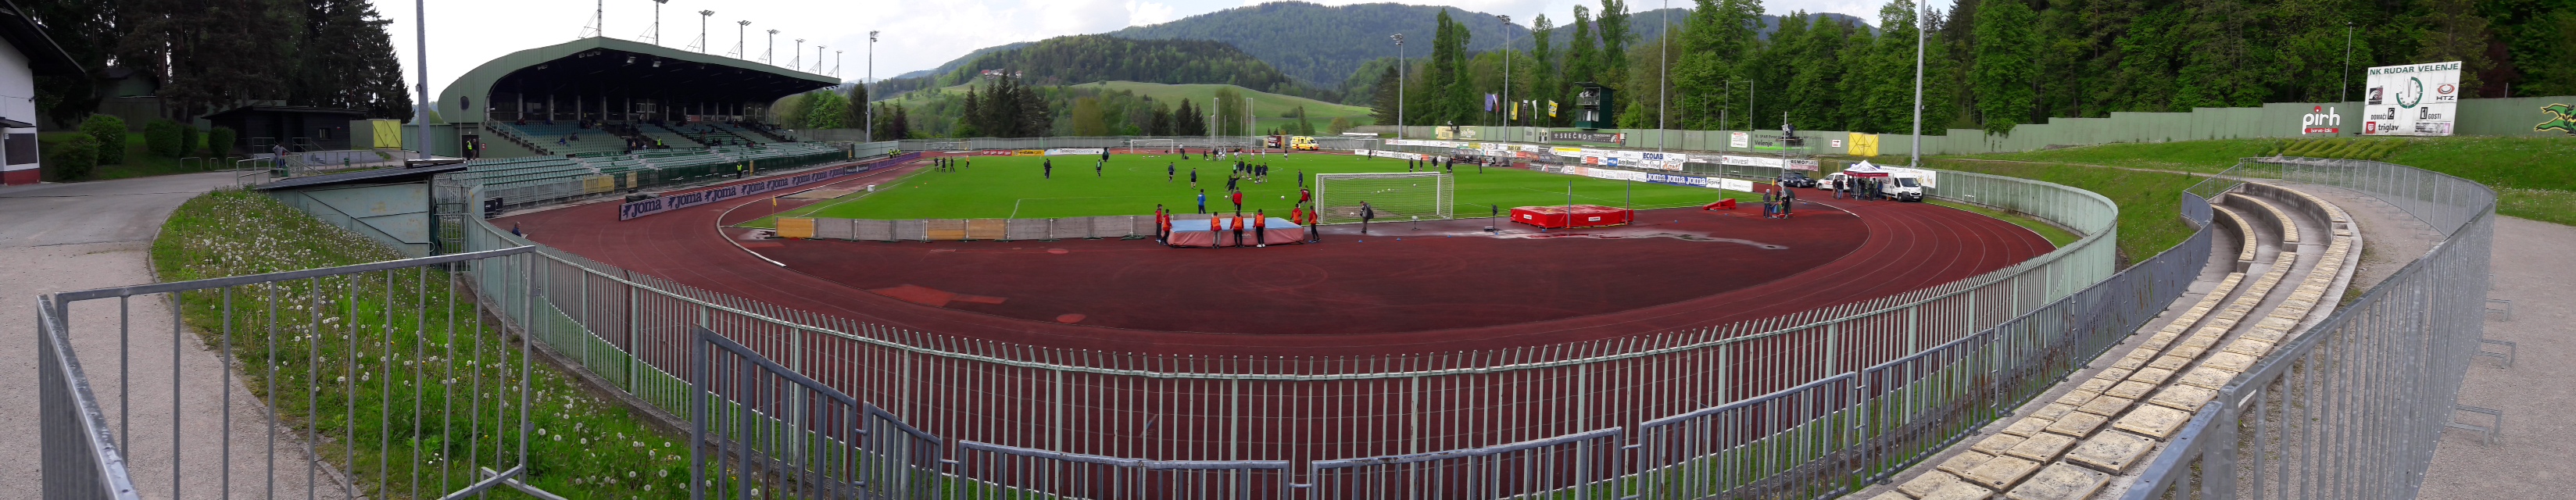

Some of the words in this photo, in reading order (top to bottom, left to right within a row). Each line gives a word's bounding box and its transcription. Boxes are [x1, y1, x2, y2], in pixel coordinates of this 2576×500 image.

[2418, 63, 2459, 72] VELENJE
[2302, 105, 2341, 135] pirh
[2378, 123, 2399, 132] triglav
